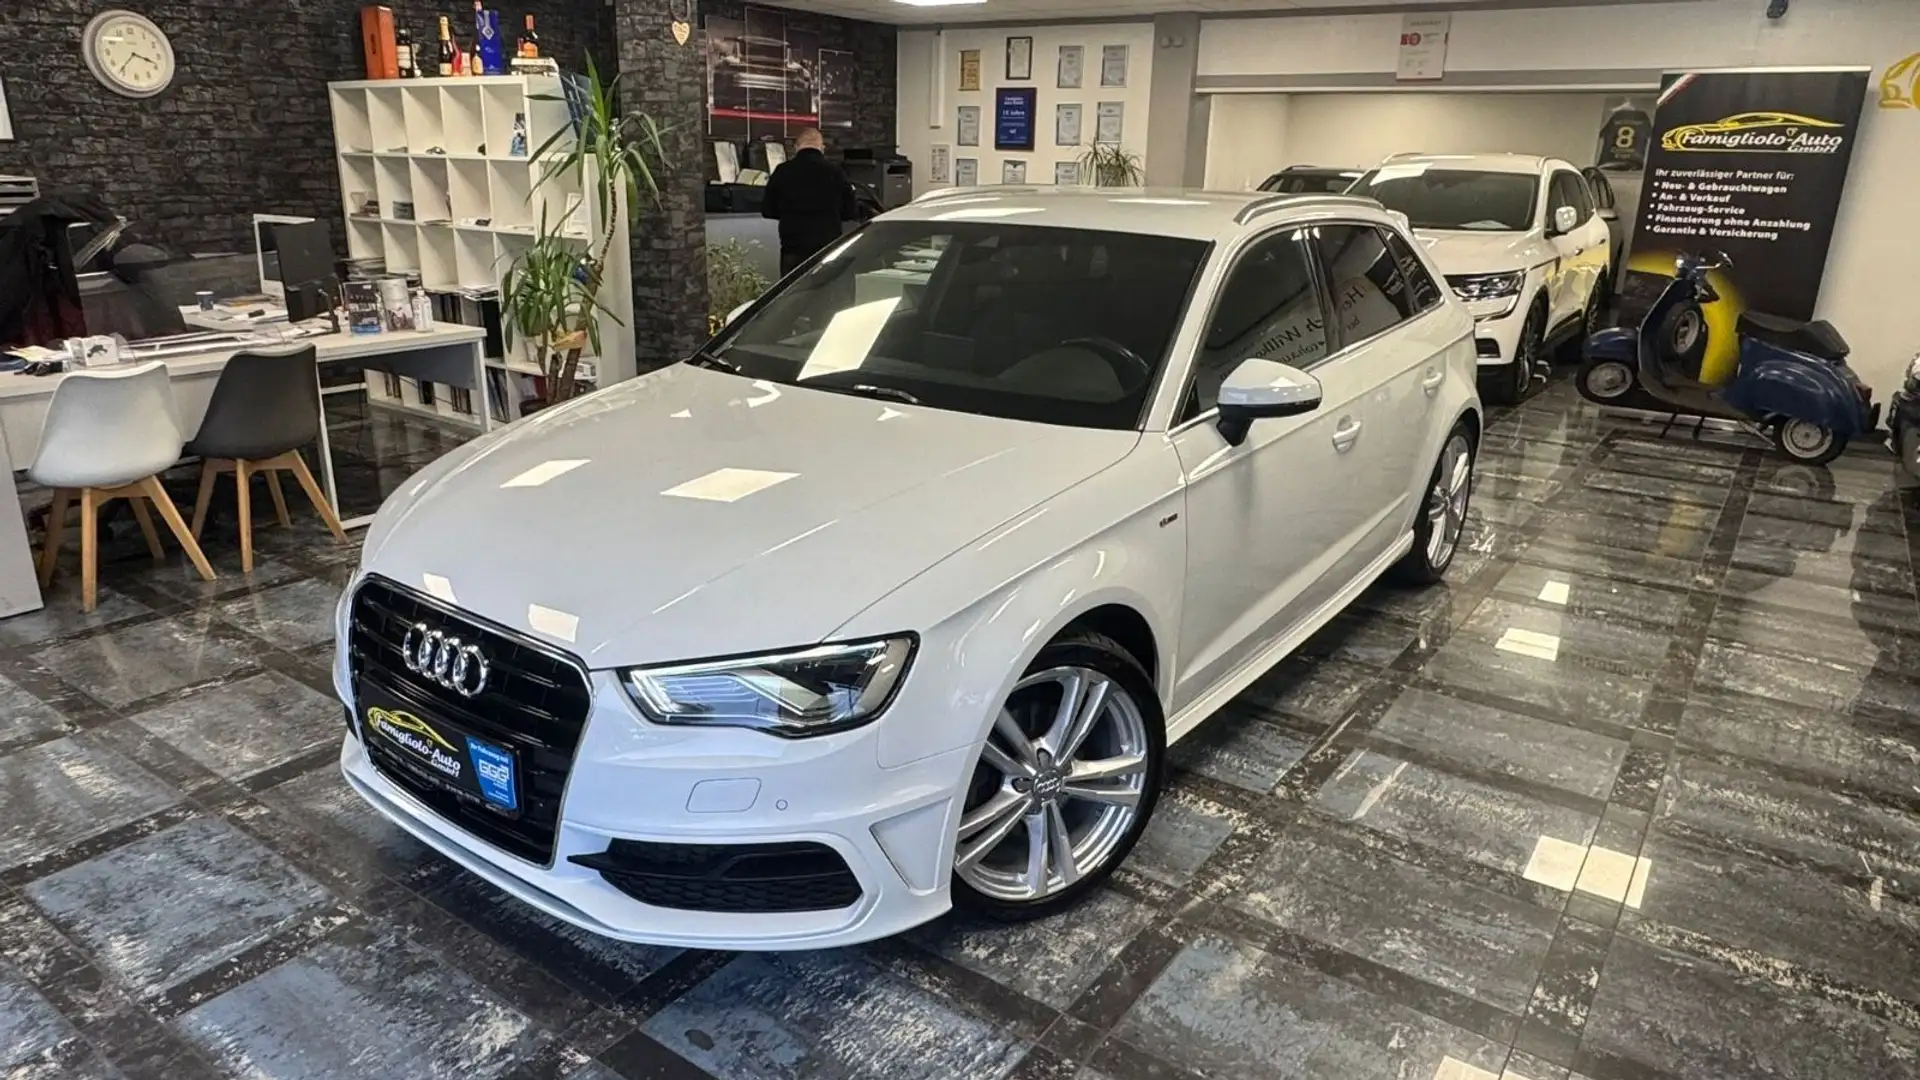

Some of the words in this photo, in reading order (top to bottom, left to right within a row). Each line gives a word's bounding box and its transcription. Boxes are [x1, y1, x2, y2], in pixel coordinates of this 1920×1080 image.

[1616, 126, 1635, 148] 8
[1655, 168, 1669, 177] Ihr
[1671, 169, 1734, 180] zuverlässiger
[1736, 170, 1774, 180] Partner
[1775, 171, 1795, 180] für:
[1661, 181, 1685, 190] Neu-
[1687, 182, 1696, 190] &
[1698, 182, 1788, 195] Gebrauchtwagen
[1659, 192, 1677, 201] An-
[1679, 192, 1688, 201] &
[1690, 193, 1732, 203] Verkauf
[1657, 203, 1746, 215] Fahrzeug-Service
[1655, 213, 1721, 226] Finanzierung
[1724, 216, 1750, 226] ohne
[1752, 218, 1811, 231] Anzahlung
[1653, 224, 1697, 235] Garantie
[1698, 226, 1707, 235] &
[1709, 227, 1779, 241] Versicherung
